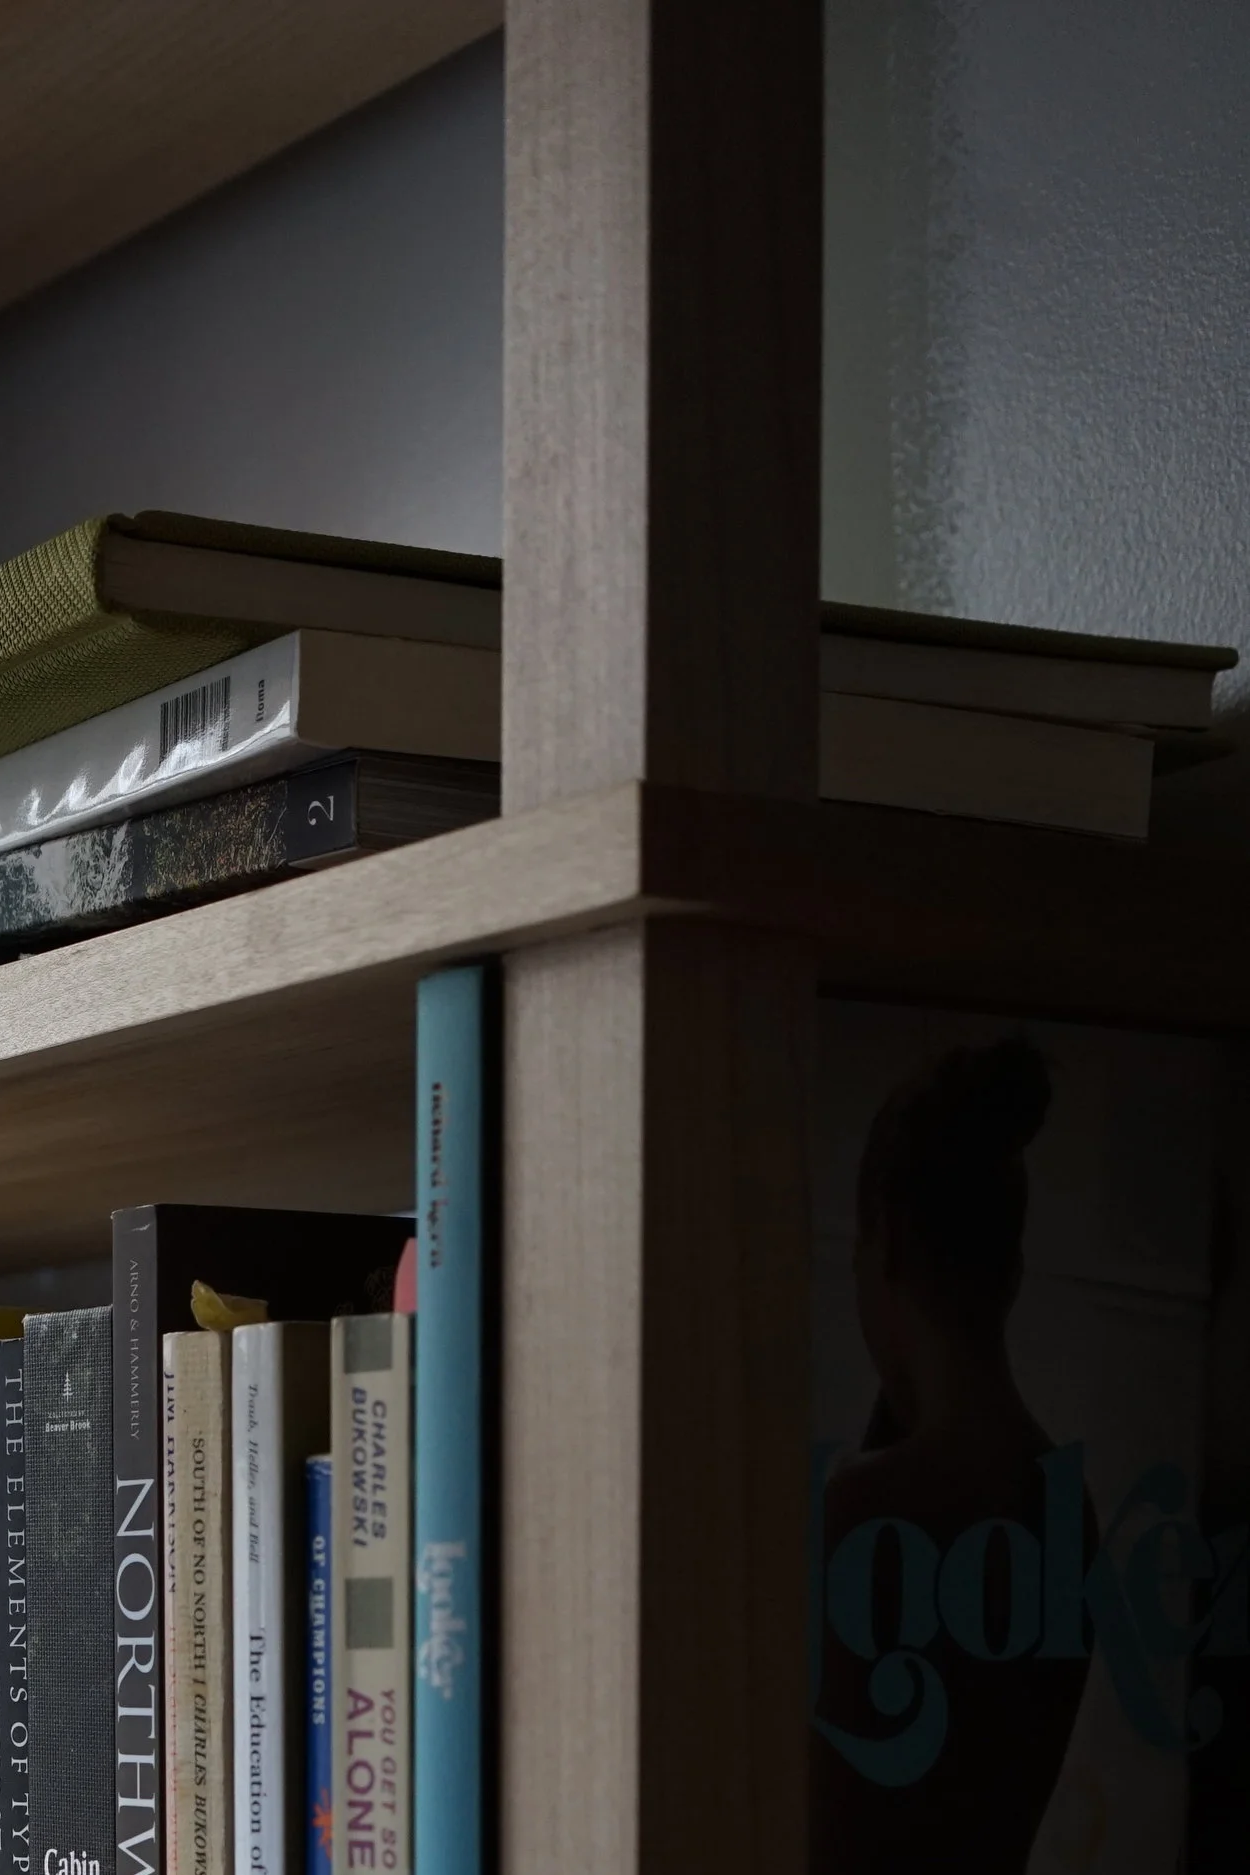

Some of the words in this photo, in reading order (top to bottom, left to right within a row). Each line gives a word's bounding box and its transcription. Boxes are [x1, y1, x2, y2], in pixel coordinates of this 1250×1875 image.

[307, 794, 335, 826] 2
[129, 1259, 140, 1313] ARNO
[129, 1319, 140, 1332] &
[4, 1368, 25, 1456] THE
[129, 1337, 141, 1440] HAMMERLY
[192, 1437, 206, 1513] SOUTH
[351, 1386, 367, 1548] BUKOWSKI
[371, 1399, 387, 1540] CHARLES
[192, 1519, 206, 1550] OF
[248, 1497, 259, 1528] and
[193, 1554, 206, 1586] NO
[312, 1535, 325, 1567] OF
[6, 1475, 28, 1703] ELEMENTS
[193, 1591, 207, 1671] NORTH
[249, 1627, 266, 1683] The
[312, 1577, 326, 1725] CHAMPIONS
[8, 1720, 30, 1774] OF
[193, 1693, 208, 1787] CHARLES
[380, 1687, 397, 1746] YOU
[249, 1695, 267, 1835] Education
[346, 1687, 376, 1870] ALONE
[380, 1755, 397, 1816] GET
[380, 1829, 397, 1871] SO
